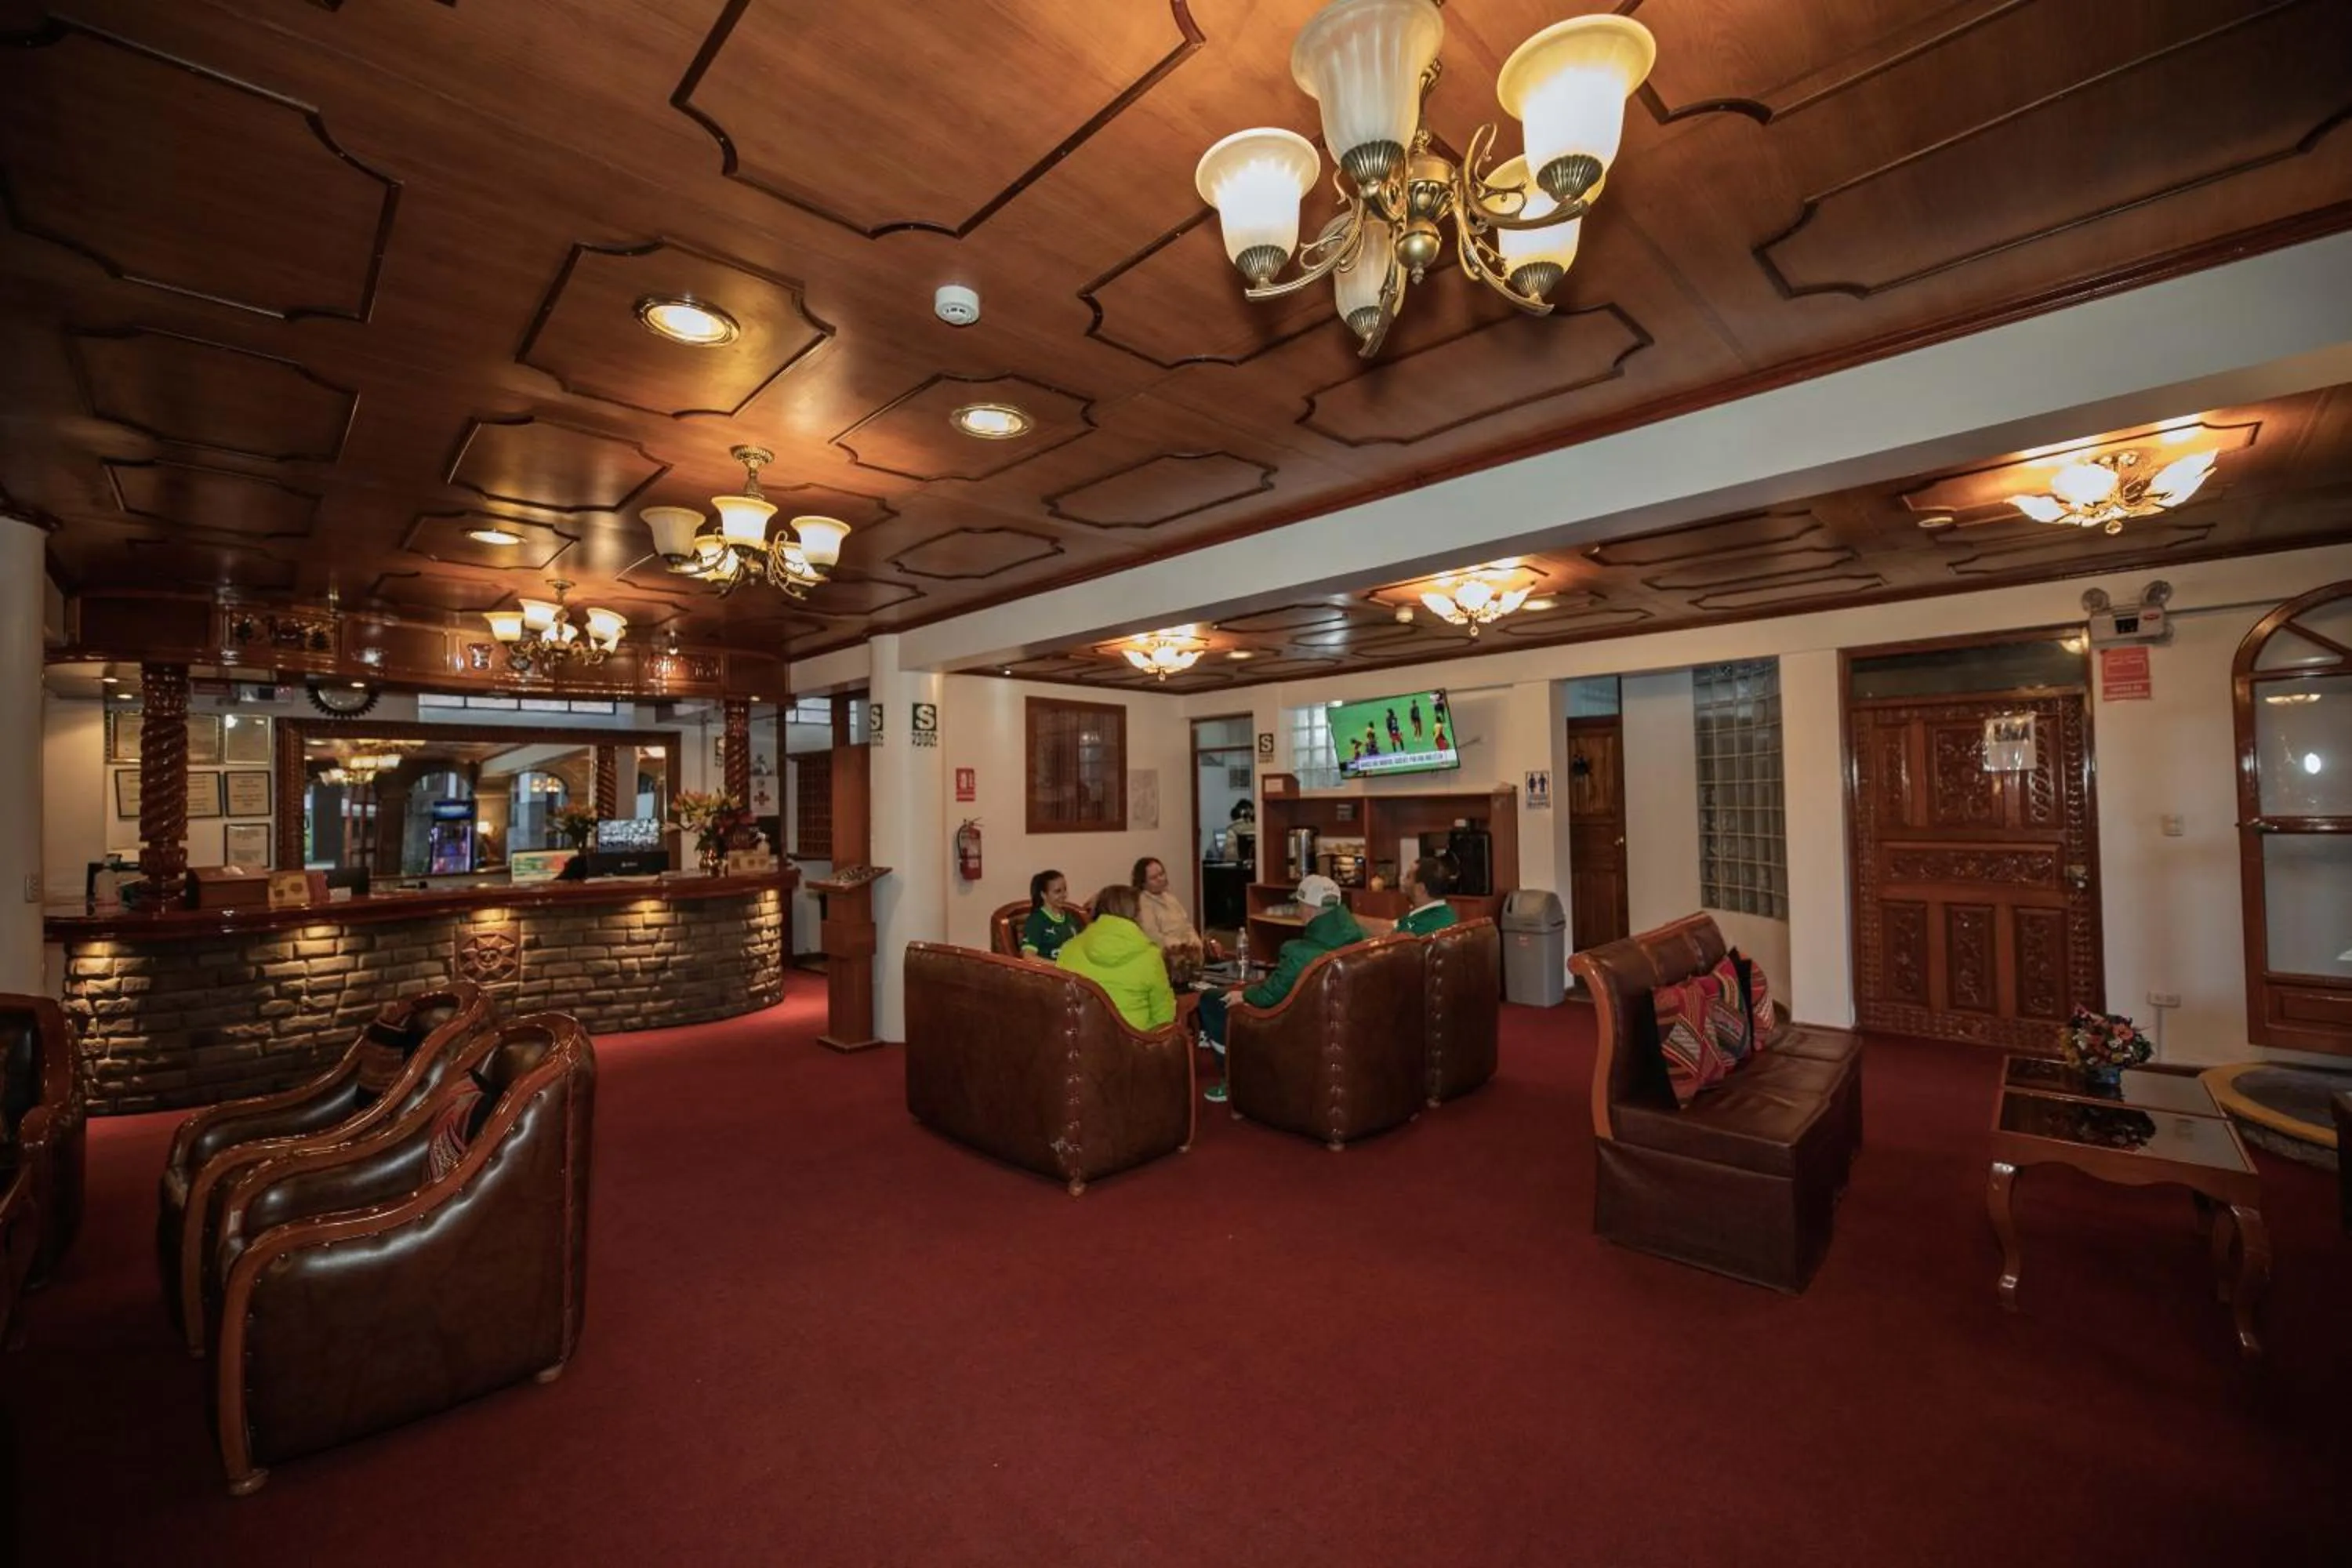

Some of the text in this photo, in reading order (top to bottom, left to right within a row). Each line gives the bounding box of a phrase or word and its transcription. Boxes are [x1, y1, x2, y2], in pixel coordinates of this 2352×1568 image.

[870, 706, 880, 730] S
[915, 705, 935, 730] S
[1261, 735, 1272, 752] S
